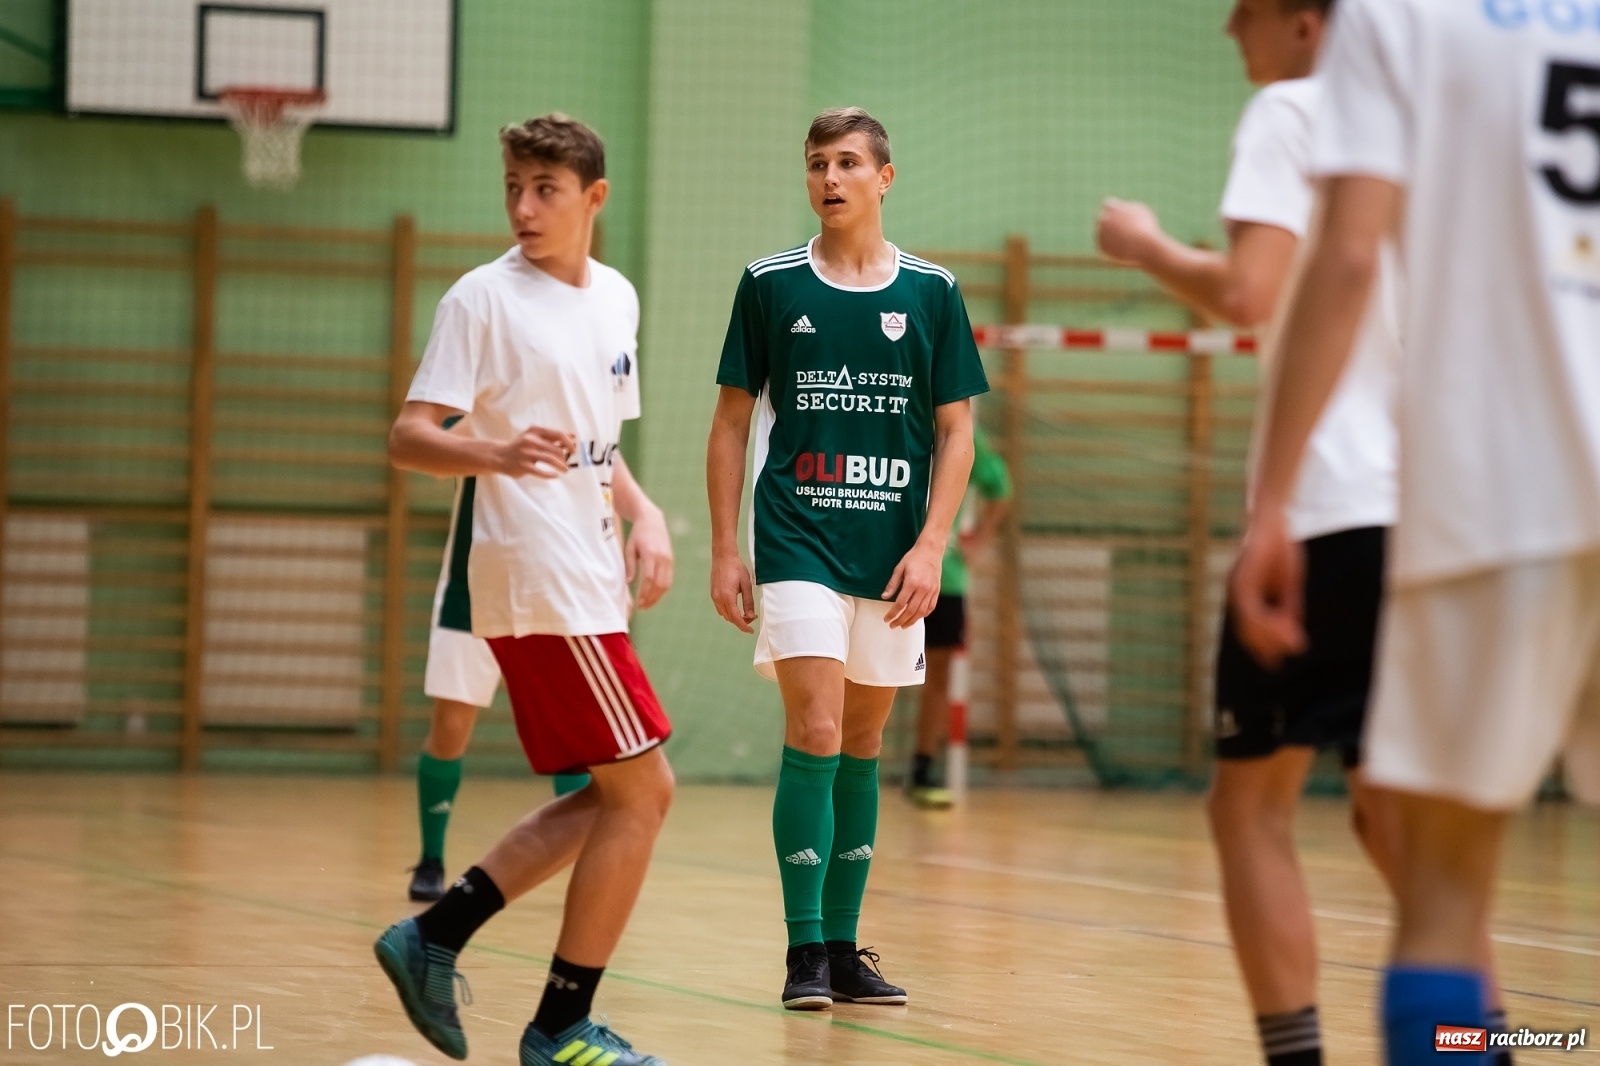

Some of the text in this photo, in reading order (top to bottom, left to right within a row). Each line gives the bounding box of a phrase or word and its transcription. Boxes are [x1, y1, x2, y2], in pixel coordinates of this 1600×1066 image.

[1540, 58, 1600, 210] 5
[790, 325, 817, 334] adidas
[795, 452, 911, 488] OLIBUD
[796, 486, 902, 502] USŁUGI BRUKARSKIE
[811, 497, 886, 512] PIOTR BADURA
